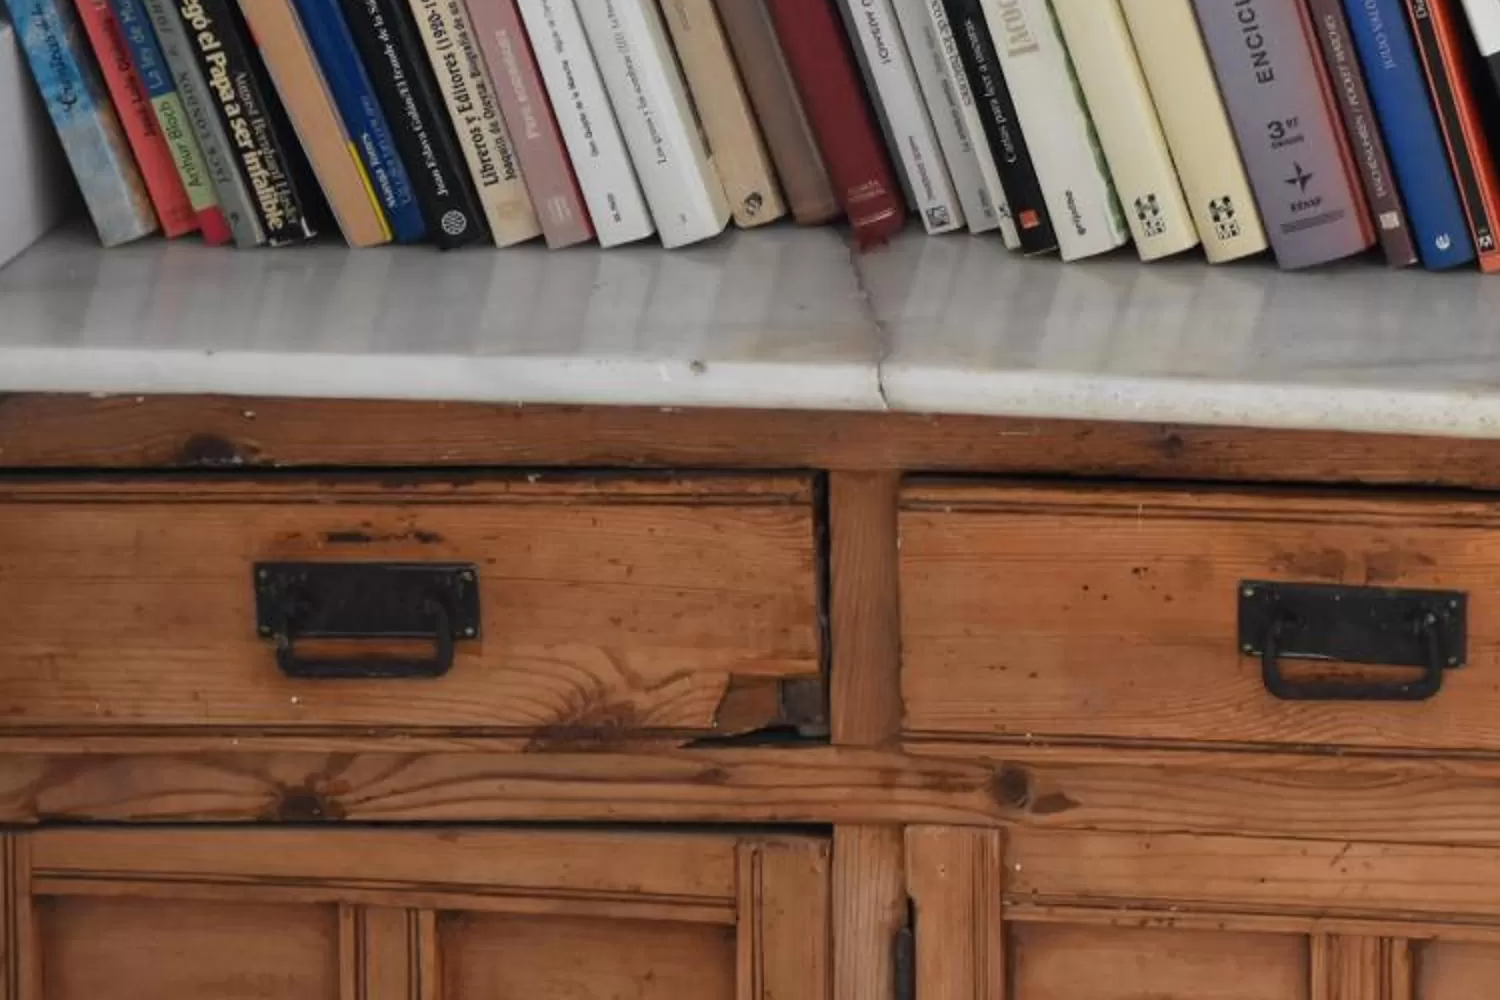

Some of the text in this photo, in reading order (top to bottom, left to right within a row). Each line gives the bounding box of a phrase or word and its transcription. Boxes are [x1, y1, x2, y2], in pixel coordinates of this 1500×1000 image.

[451, 15, 464, 31] de
[197, 30, 221, 51] el
[145, 69, 163, 89] La
[205, 51, 241, 101] Papa
[443, 52, 473, 113] Editores
[224, 102, 240, 117] a
[464, 112, 481, 126] y
[178, 71, 231, 184] JACK LONDON
[229, 117, 254, 148] ser
[486, 120, 501, 135] de
[177, 143, 202, 187] Arthur
[469, 126, 498, 186] Libreros
[243, 150, 283, 229] infalible
